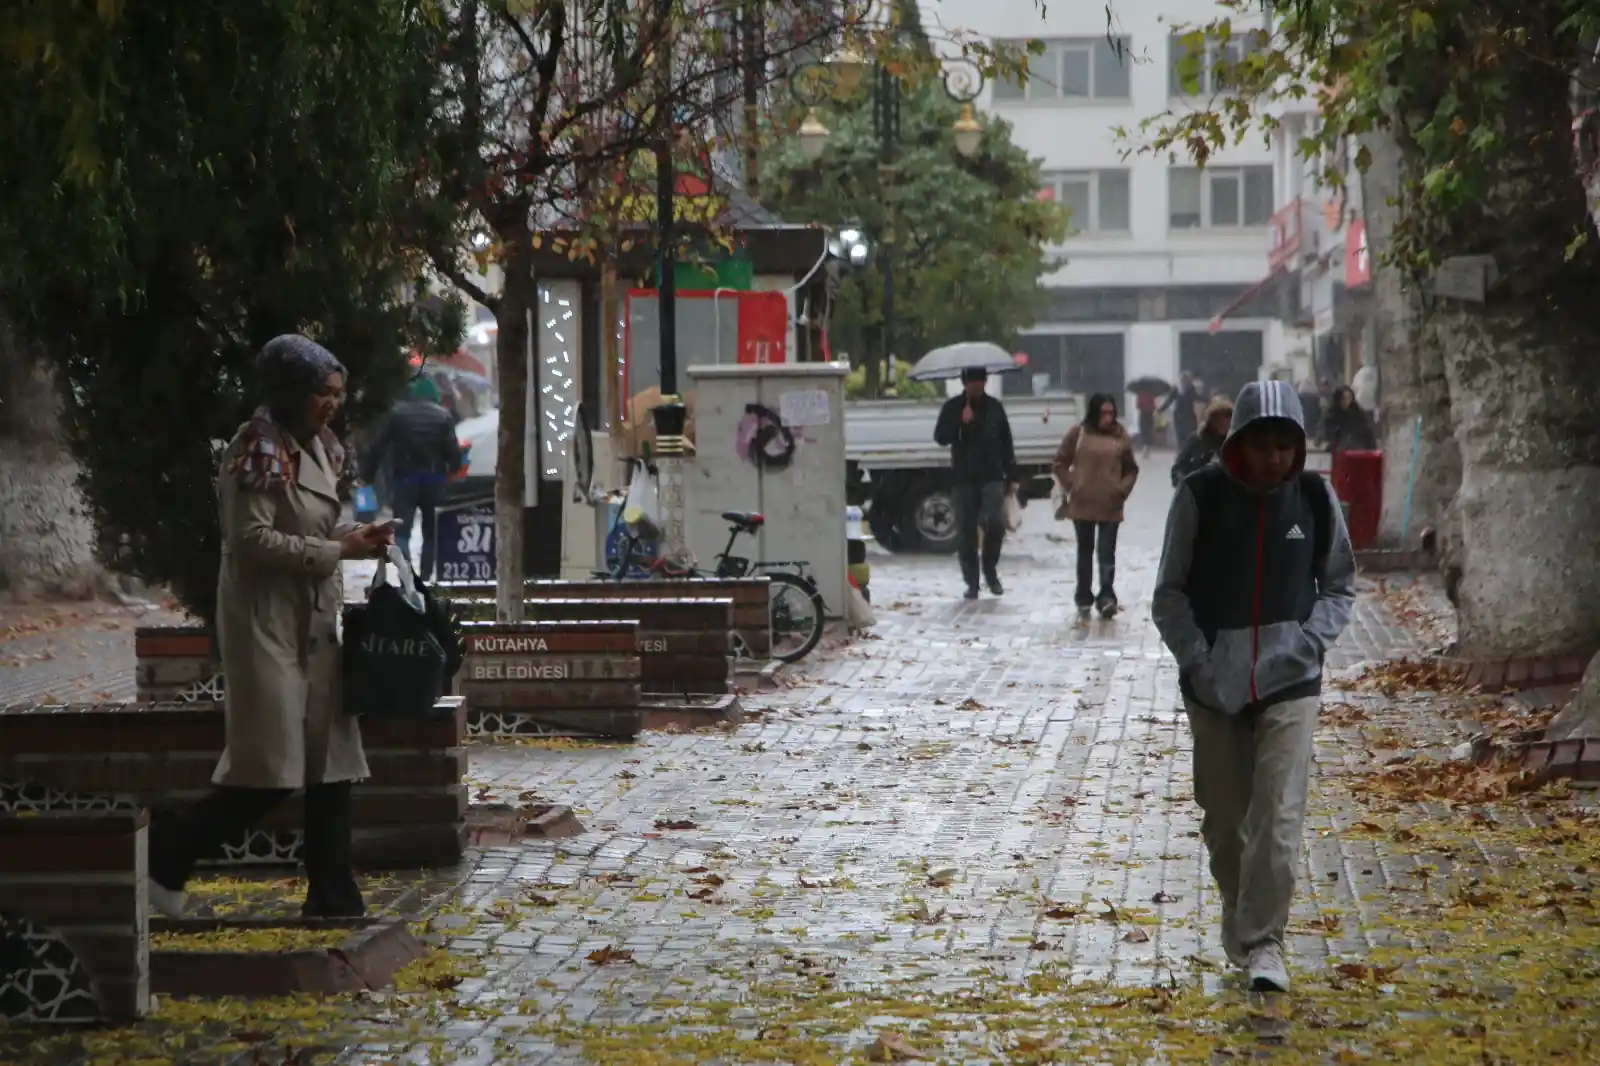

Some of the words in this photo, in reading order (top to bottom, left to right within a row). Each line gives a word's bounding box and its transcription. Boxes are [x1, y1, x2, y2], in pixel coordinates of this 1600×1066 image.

[443, 562, 469, 579] 212
[474, 562, 491, 579] 10
[474, 636, 548, 652] KÜTAHYA
[475, 663, 568, 679] BELEDİYESİ
